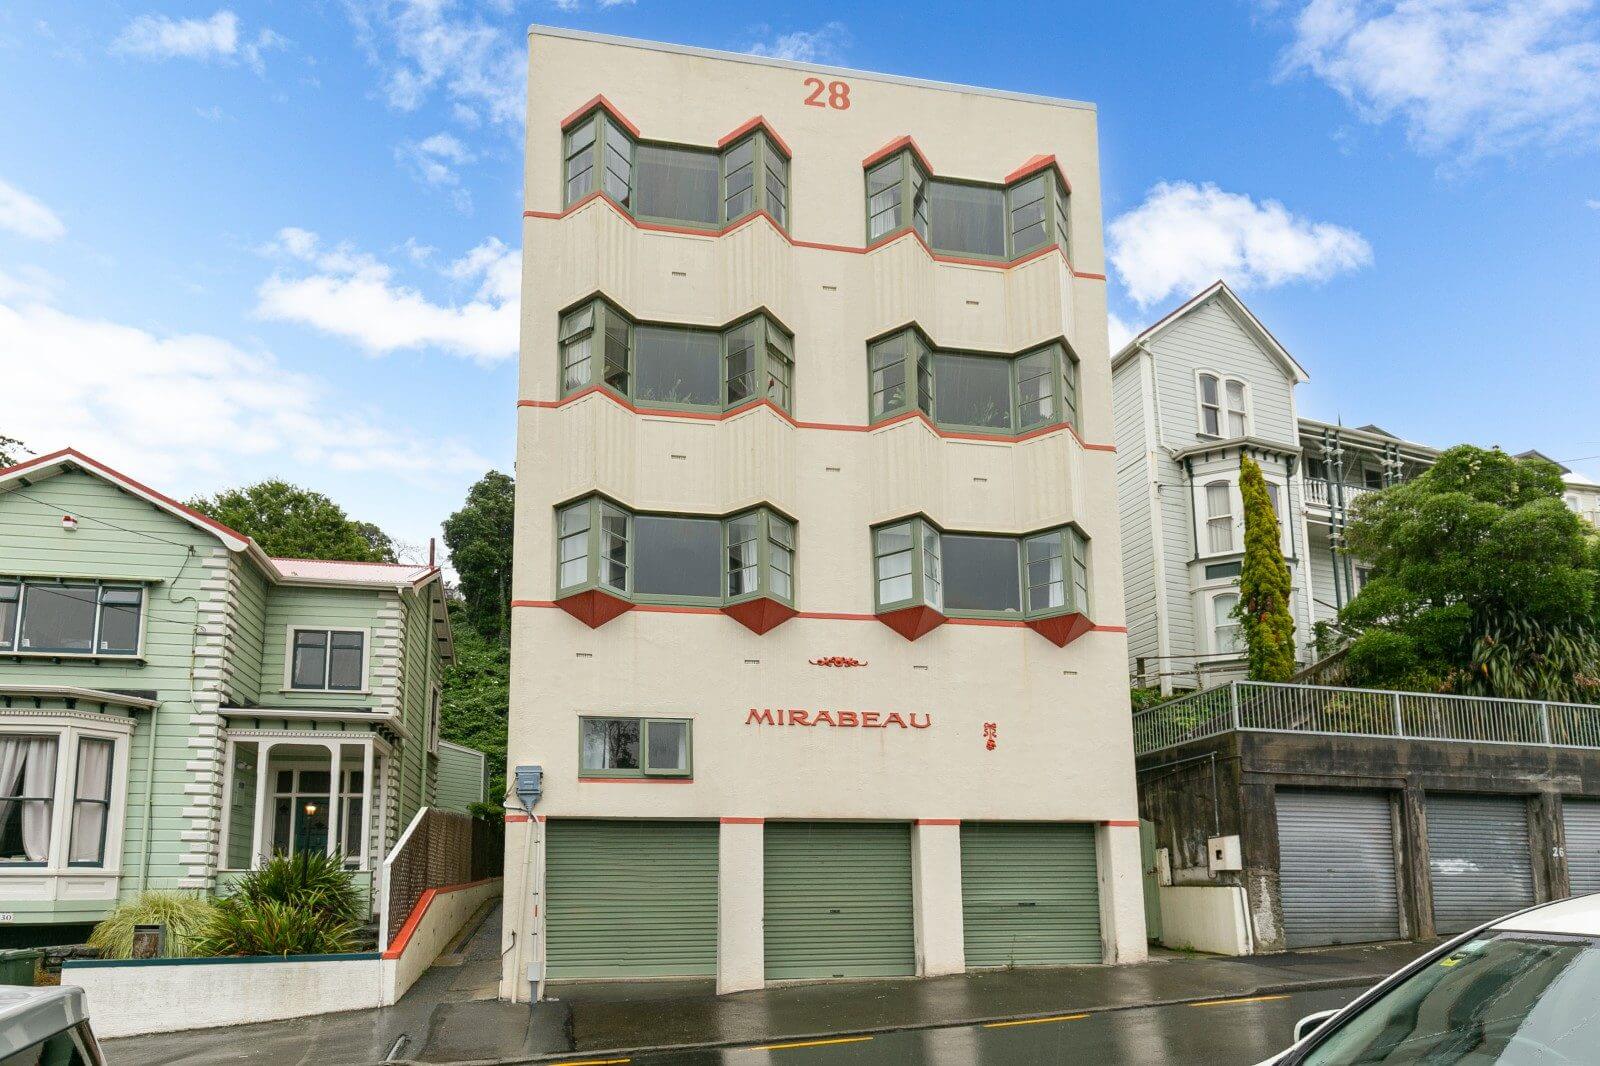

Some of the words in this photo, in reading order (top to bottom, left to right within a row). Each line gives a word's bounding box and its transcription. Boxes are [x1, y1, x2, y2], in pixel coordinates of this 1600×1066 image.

[804, 77, 850, 110] 28
[745, 708, 932, 729] MIRABEAU
[1552, 846, 1565, 857] 26
